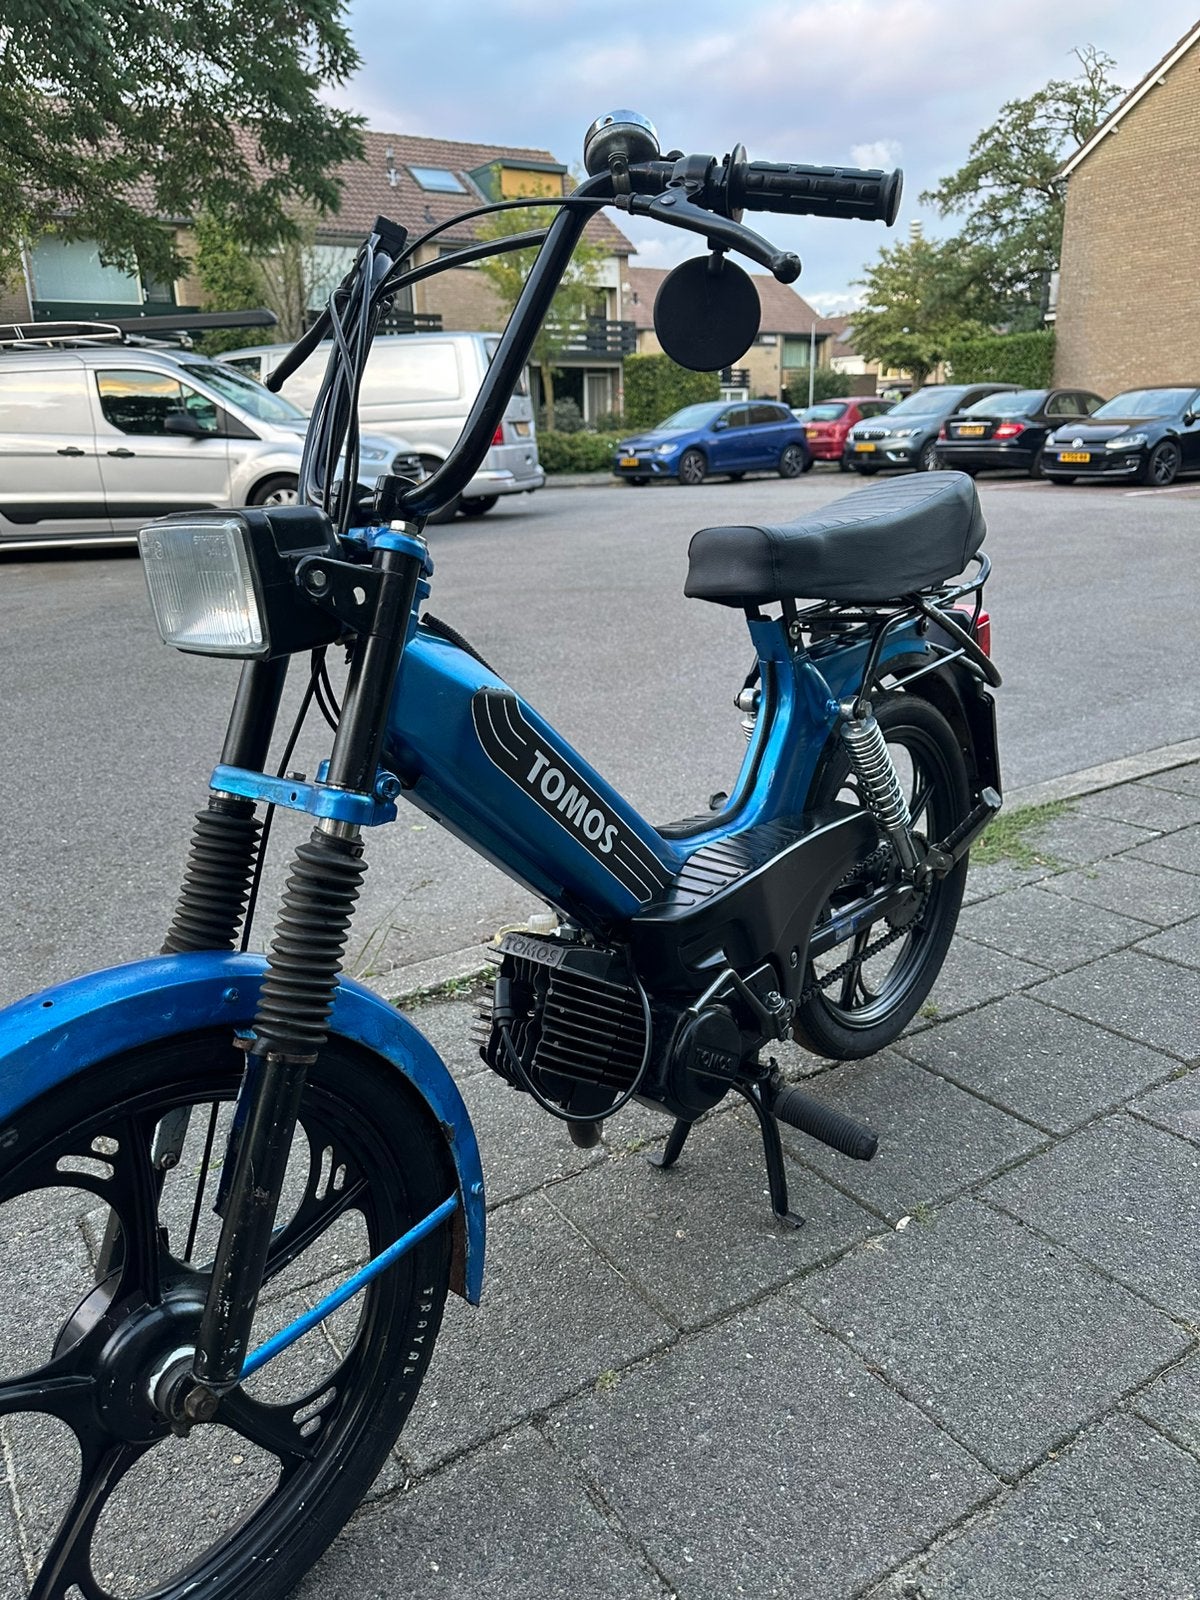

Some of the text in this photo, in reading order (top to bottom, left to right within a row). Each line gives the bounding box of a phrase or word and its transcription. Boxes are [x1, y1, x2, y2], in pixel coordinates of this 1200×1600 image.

[525, 749, 619, 854] TOMOS
[505, 935, 560, 964] TOMOS
[402, 1286, 434, 1379] TRAYAL
